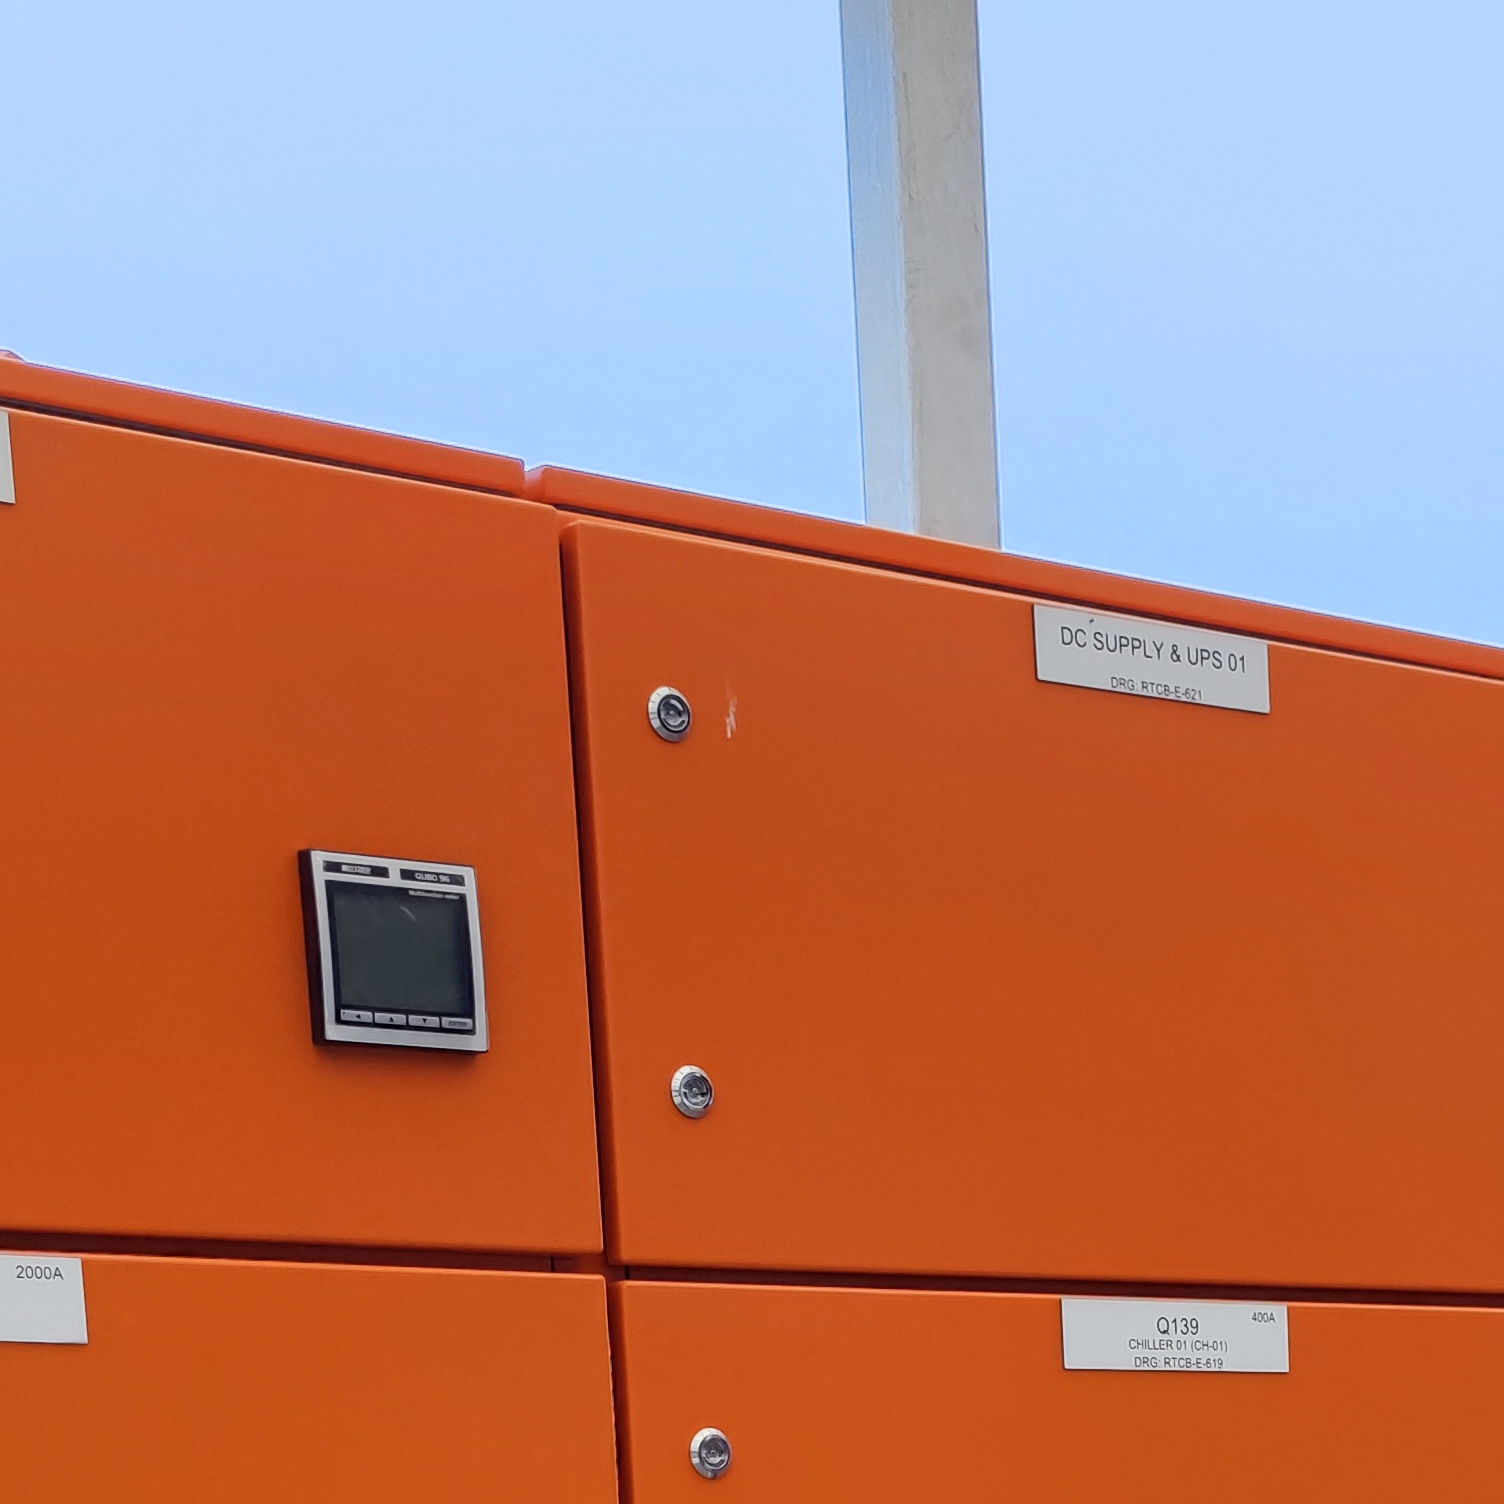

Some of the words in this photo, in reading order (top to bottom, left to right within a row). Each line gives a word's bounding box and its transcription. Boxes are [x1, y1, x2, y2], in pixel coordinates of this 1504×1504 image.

[1061, 626, 1087, 647] DC
[1093, 631, 1164, 660] SUPPLY
[1170, 644, 1181, 663] &
[1186, 647, 1222, 670] UPS
[1228, 654, 1246, 673] 01
[1111, 676, 1138, 691] DRG:
[1141, 683, 1202, 701] RTCB-E-621
[16, 1265, 63, 1281] 2000A
[1252, 1312, 1276, 1323] 400A
[1157, 1317, 1199, 1335] Q139
[1129, 1339, 1174, 1350] CHILLER
[1176, 1340, 1188, 1350] 01
[1191, 1340, 1228, 1353] (CH-01)
[1135, 1357, 1161, 1368] DRG:
[1164, 1357, 1223, 1369] RTCB-E-619
